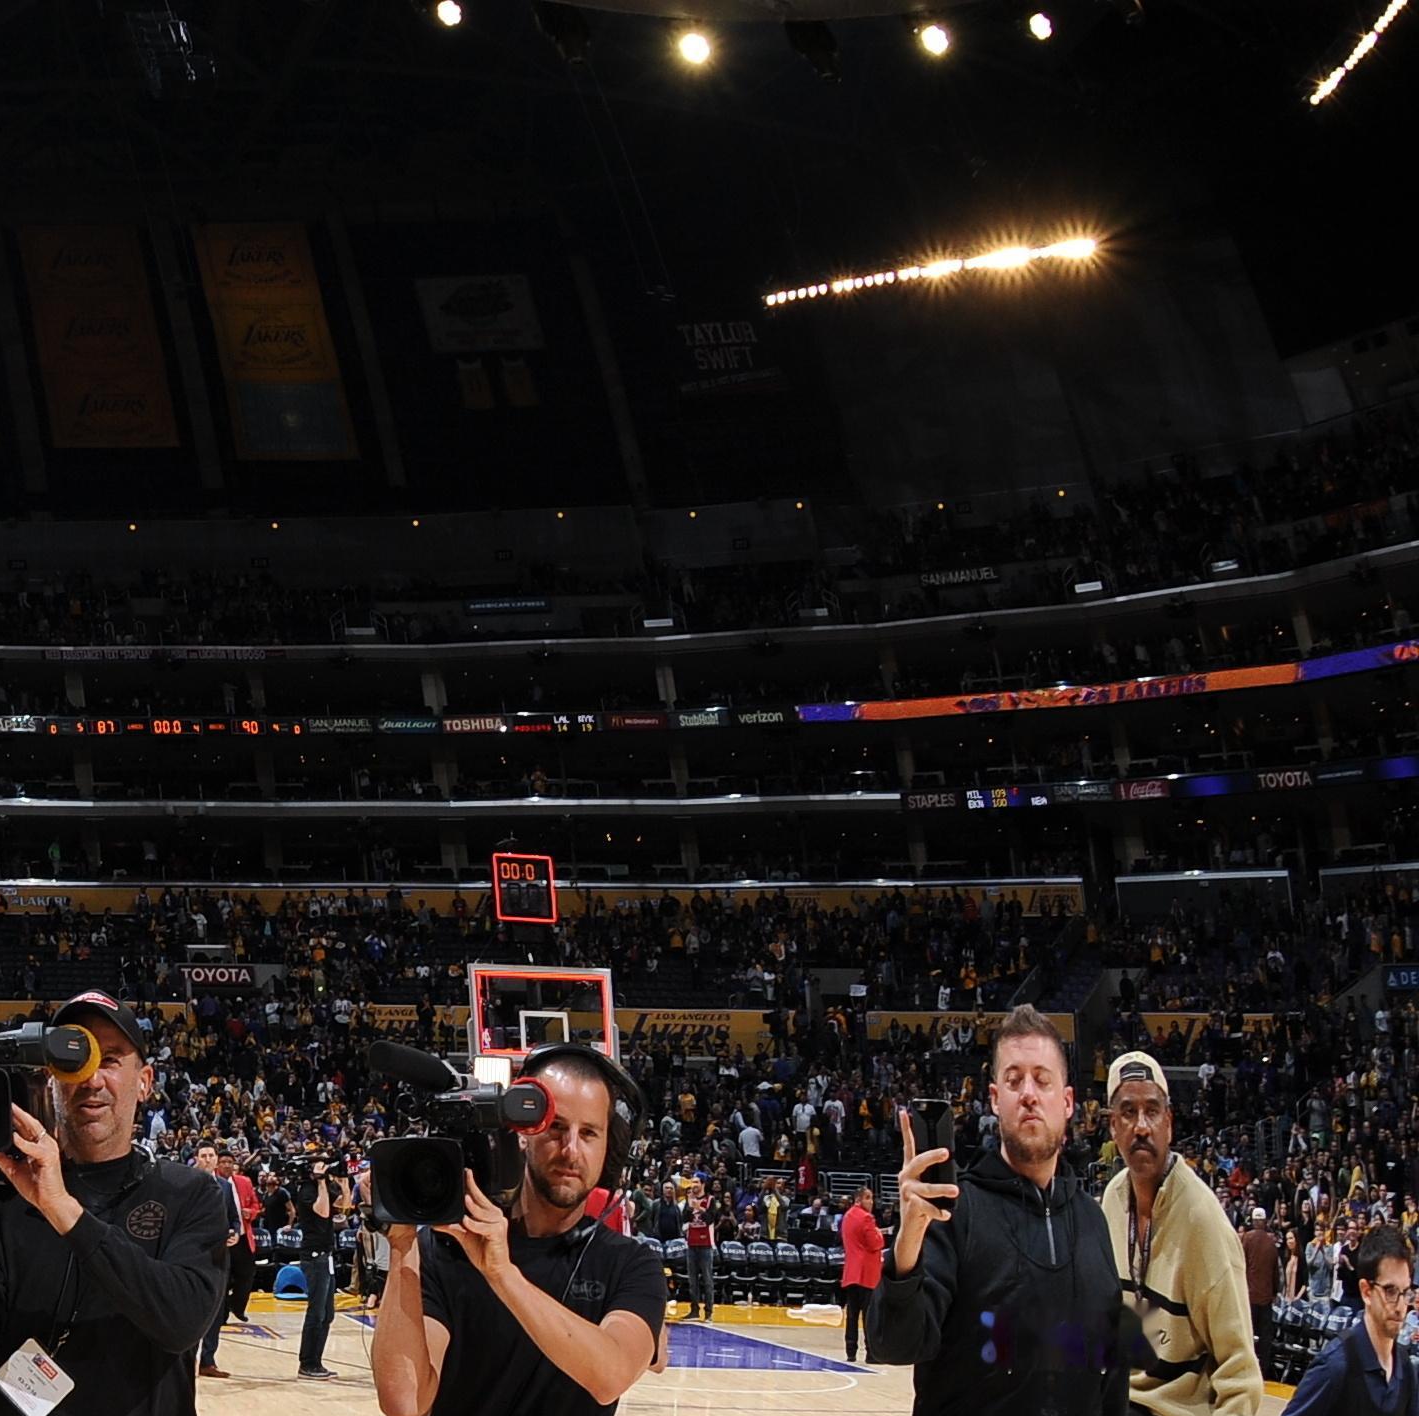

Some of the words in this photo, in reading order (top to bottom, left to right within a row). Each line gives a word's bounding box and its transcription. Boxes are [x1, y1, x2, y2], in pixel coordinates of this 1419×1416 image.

[677, 321, 758, 346] TAYLOR
[694, 346, 754, 370] SWIFT
[443, 718, 504, 731] TOSHIBA
[738, 711, 784, 723] verizon
[97, 720, 115, 734] 87
[241, 720, 260, 735] 90
[1257, 772, 1312, 790] TOYOTA
[907, 793, 956, 808] STAPLES
[500, 862, 535, 880] 00.0
[180, 967, 252, 983] TOYOTA
[655, 1012, 680, 1021] LOS
[681, 1012, 731, 1021] ANGELES
